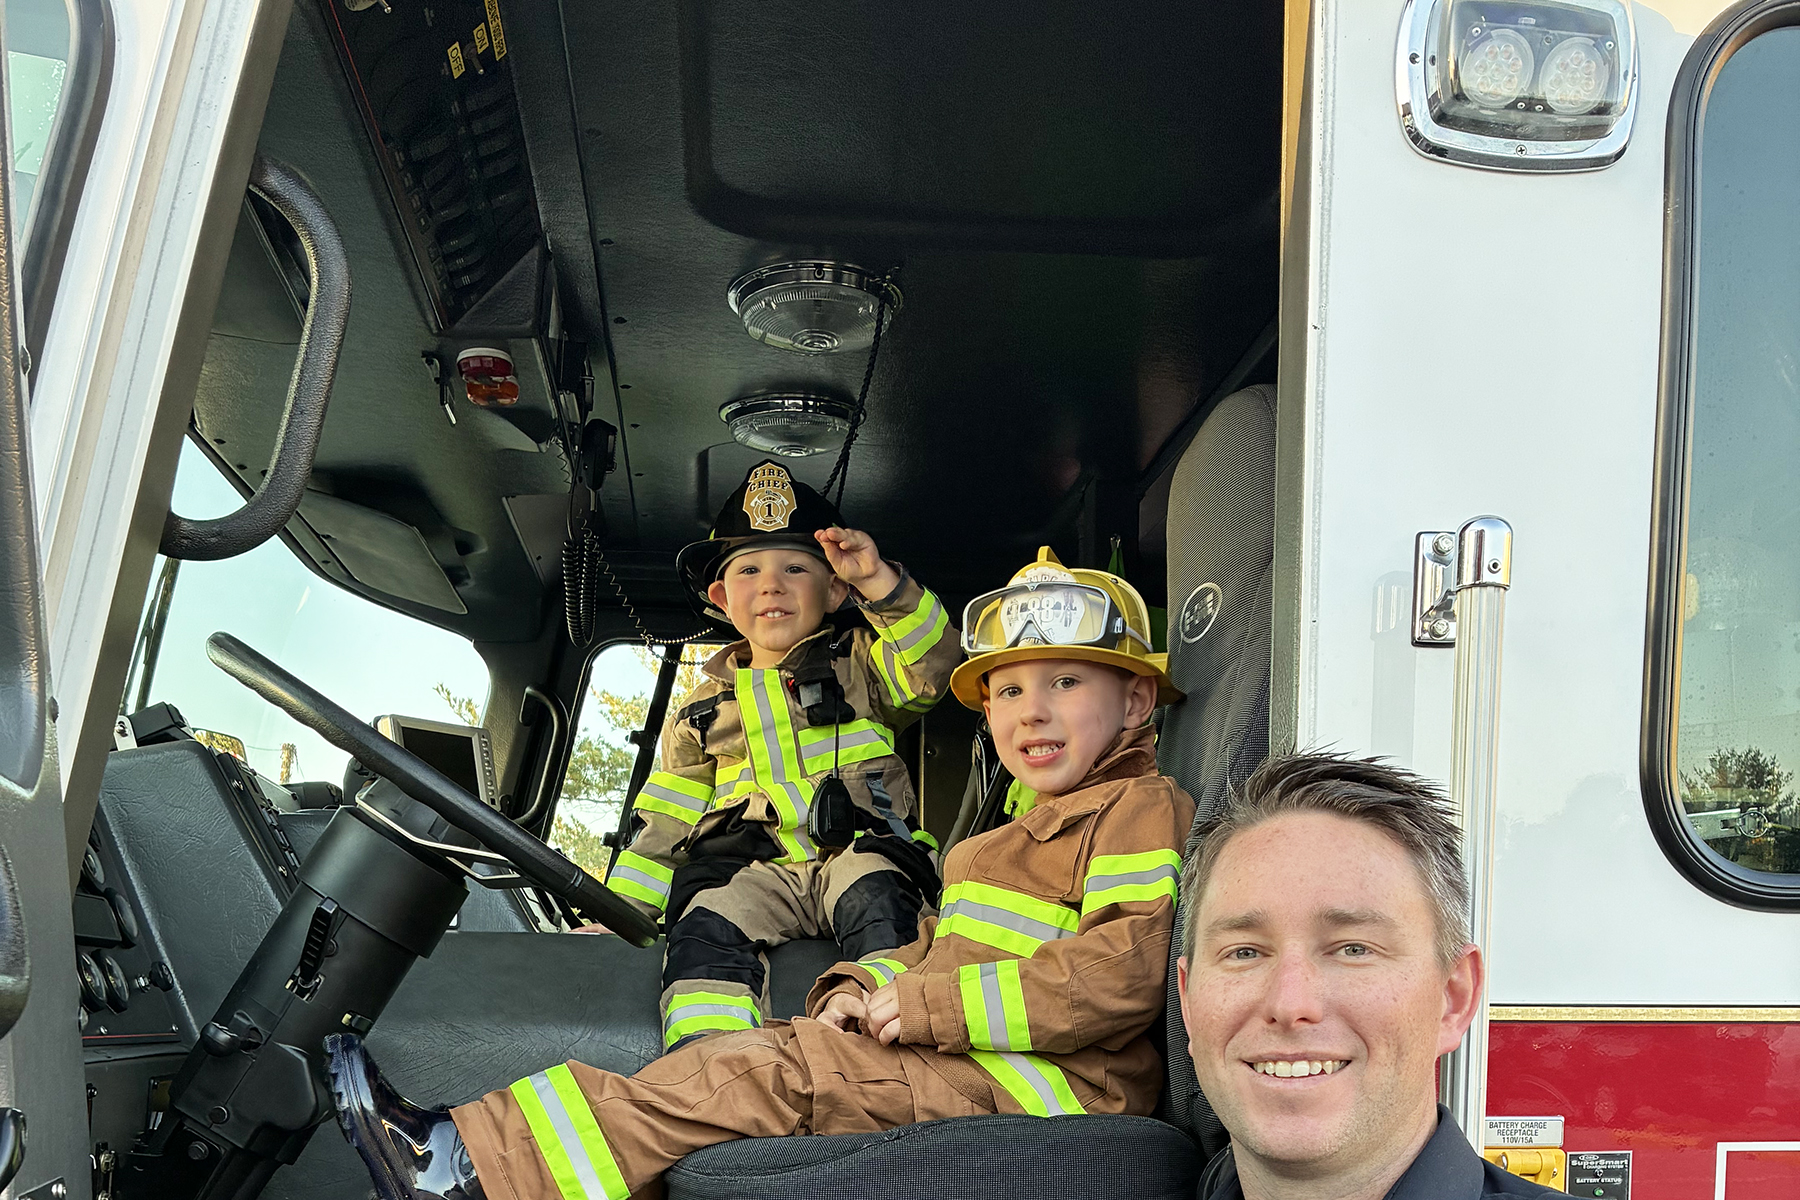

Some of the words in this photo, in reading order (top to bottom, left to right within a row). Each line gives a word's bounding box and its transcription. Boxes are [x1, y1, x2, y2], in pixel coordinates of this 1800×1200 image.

[476, 28, 487, 49] ON
[450, 47, 463, 71] OFF
[754, 468, 784, 478] FIRE
[749, 479, 788, 492] CHIEF
[765, 503, 775, 518] 1
[1489, 1121, 1519, 1129] BATTERY
[1520, 1121, 1547, 1129] CHARGE
[1571, 1160, 1628, 1169] SuperSmart
